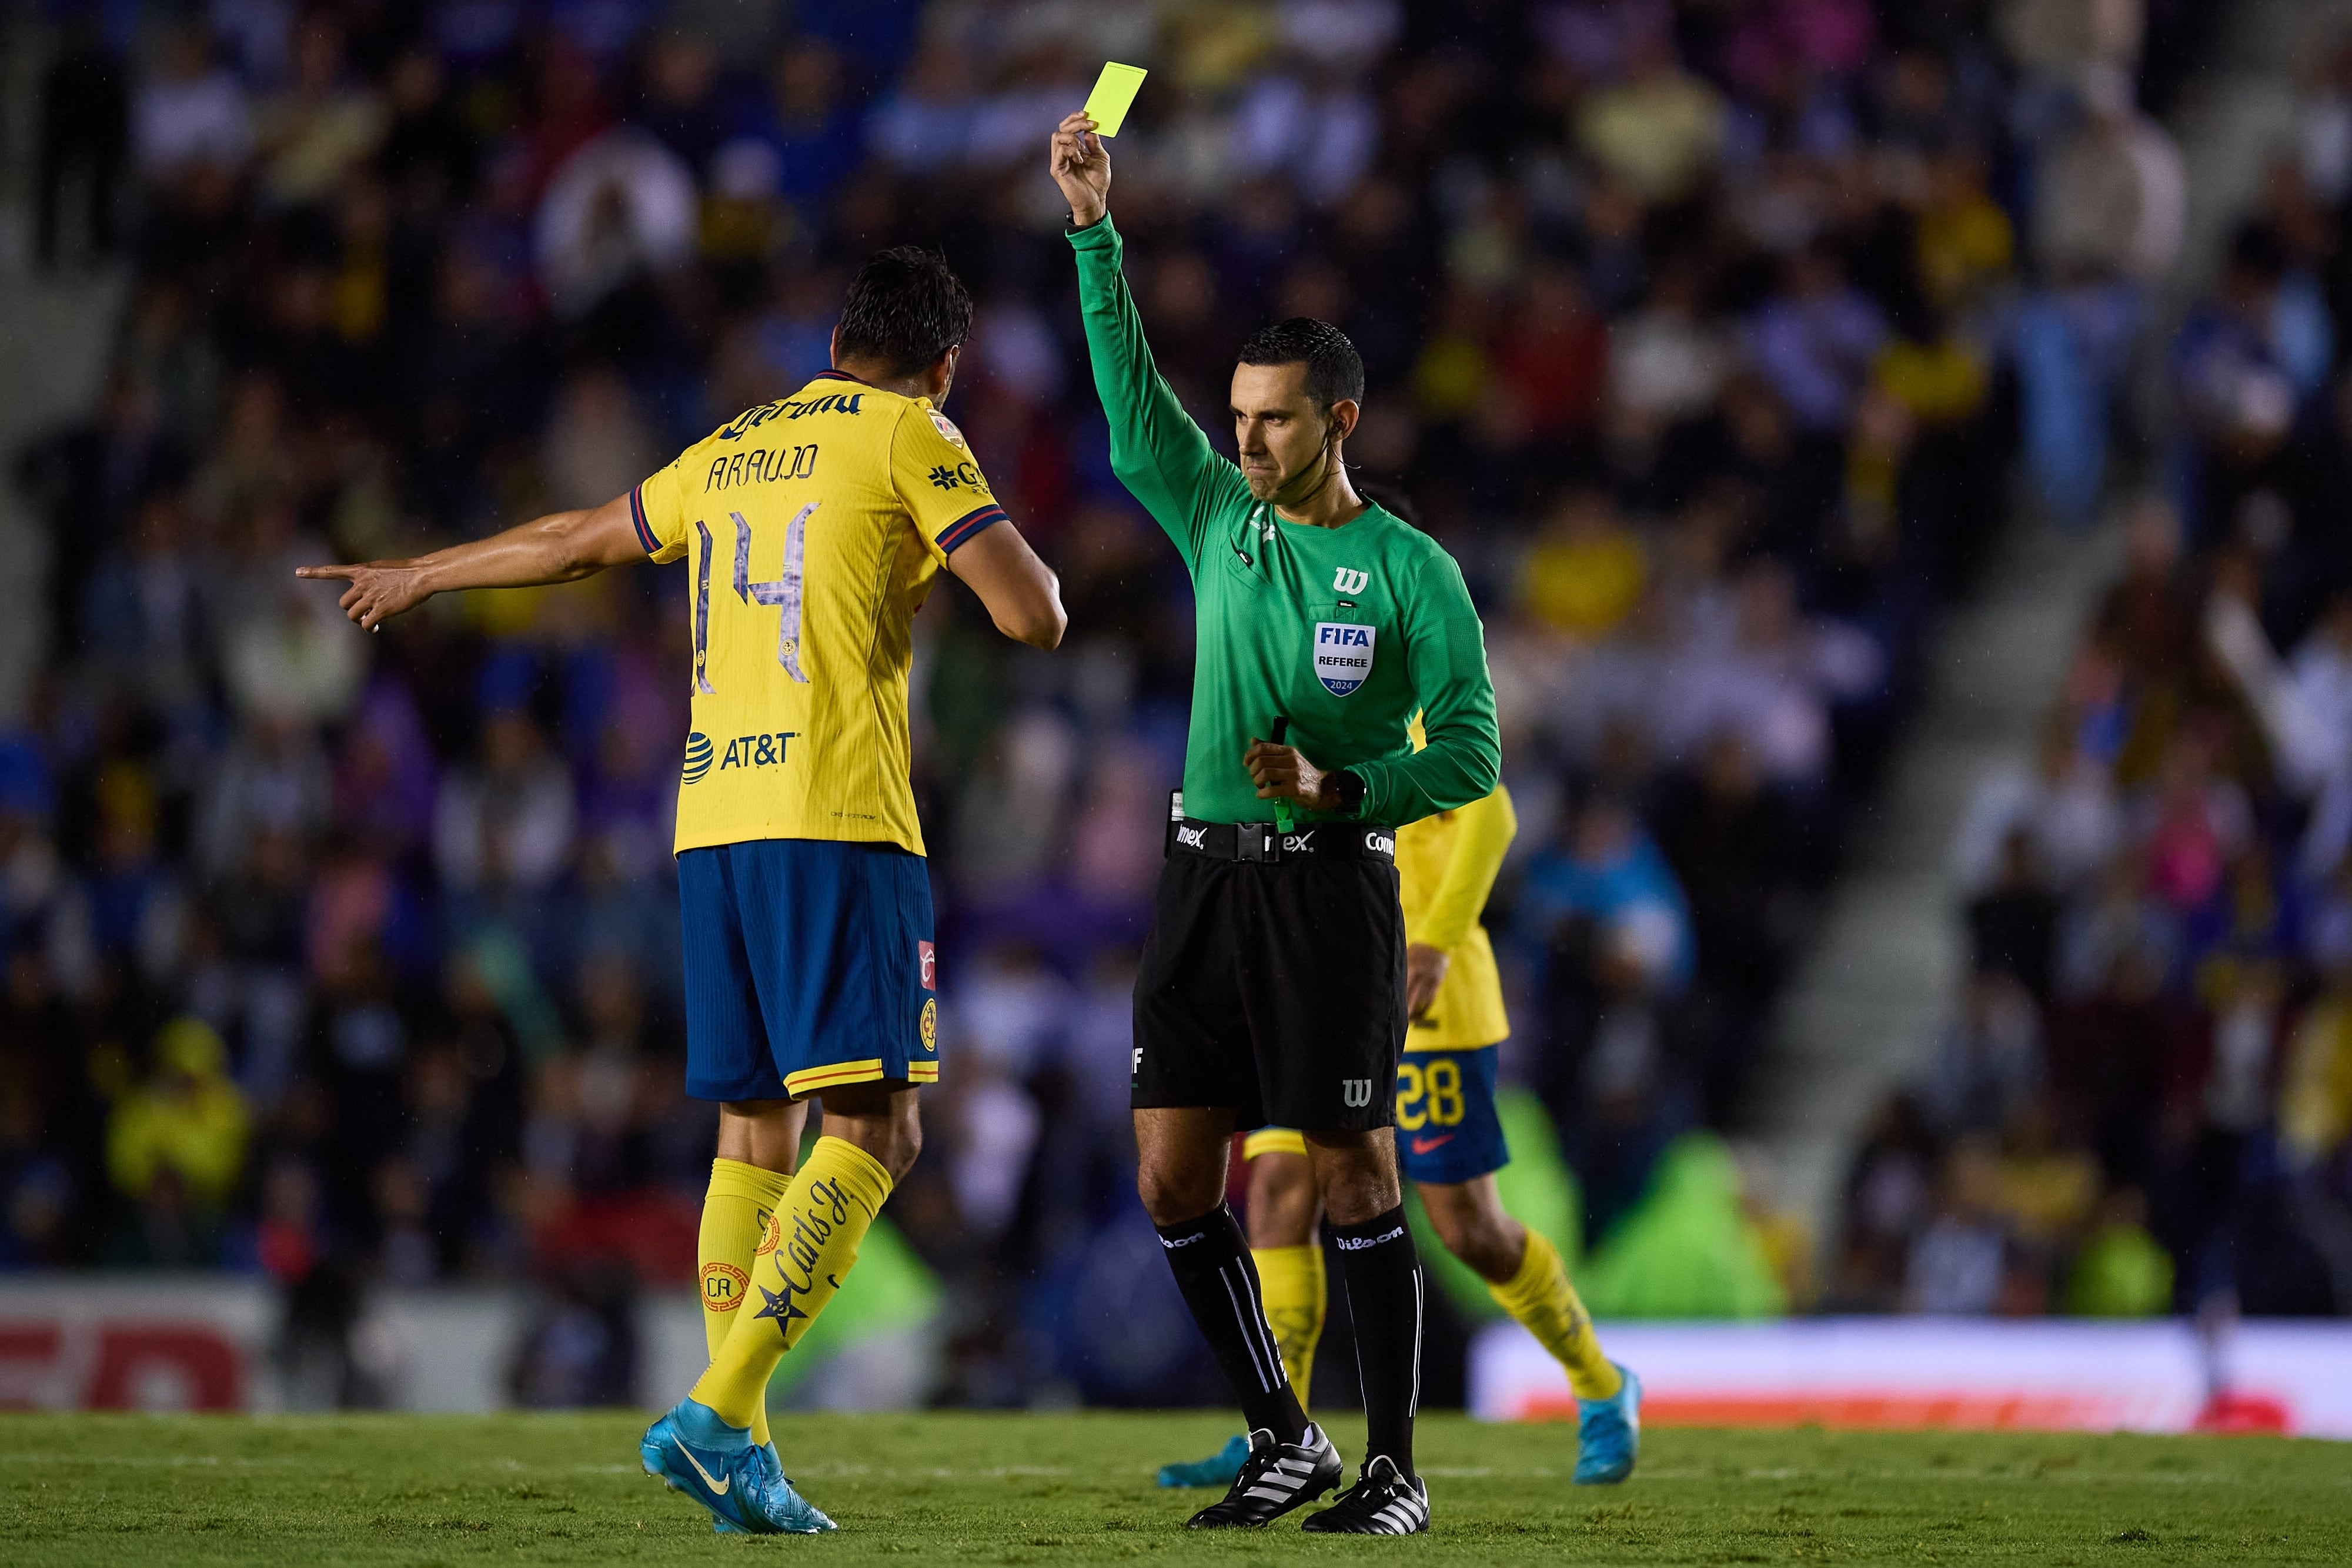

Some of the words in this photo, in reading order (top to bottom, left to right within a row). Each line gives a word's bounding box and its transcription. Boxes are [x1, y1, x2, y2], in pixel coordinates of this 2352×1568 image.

[703, 444, 818, 493] ARAUJO
[695, 502, 823, 695] 14
[1320, 627, 1369, 647] FIFA
[1318, 656, 1368, 668] REFEREE
[1330, 680, 1352, 690] 2024
[720, 732, 796, 770] AT&T
[1396, 1058, 1465, 1131] 28
[707, 1278, 732, 1297] CA
